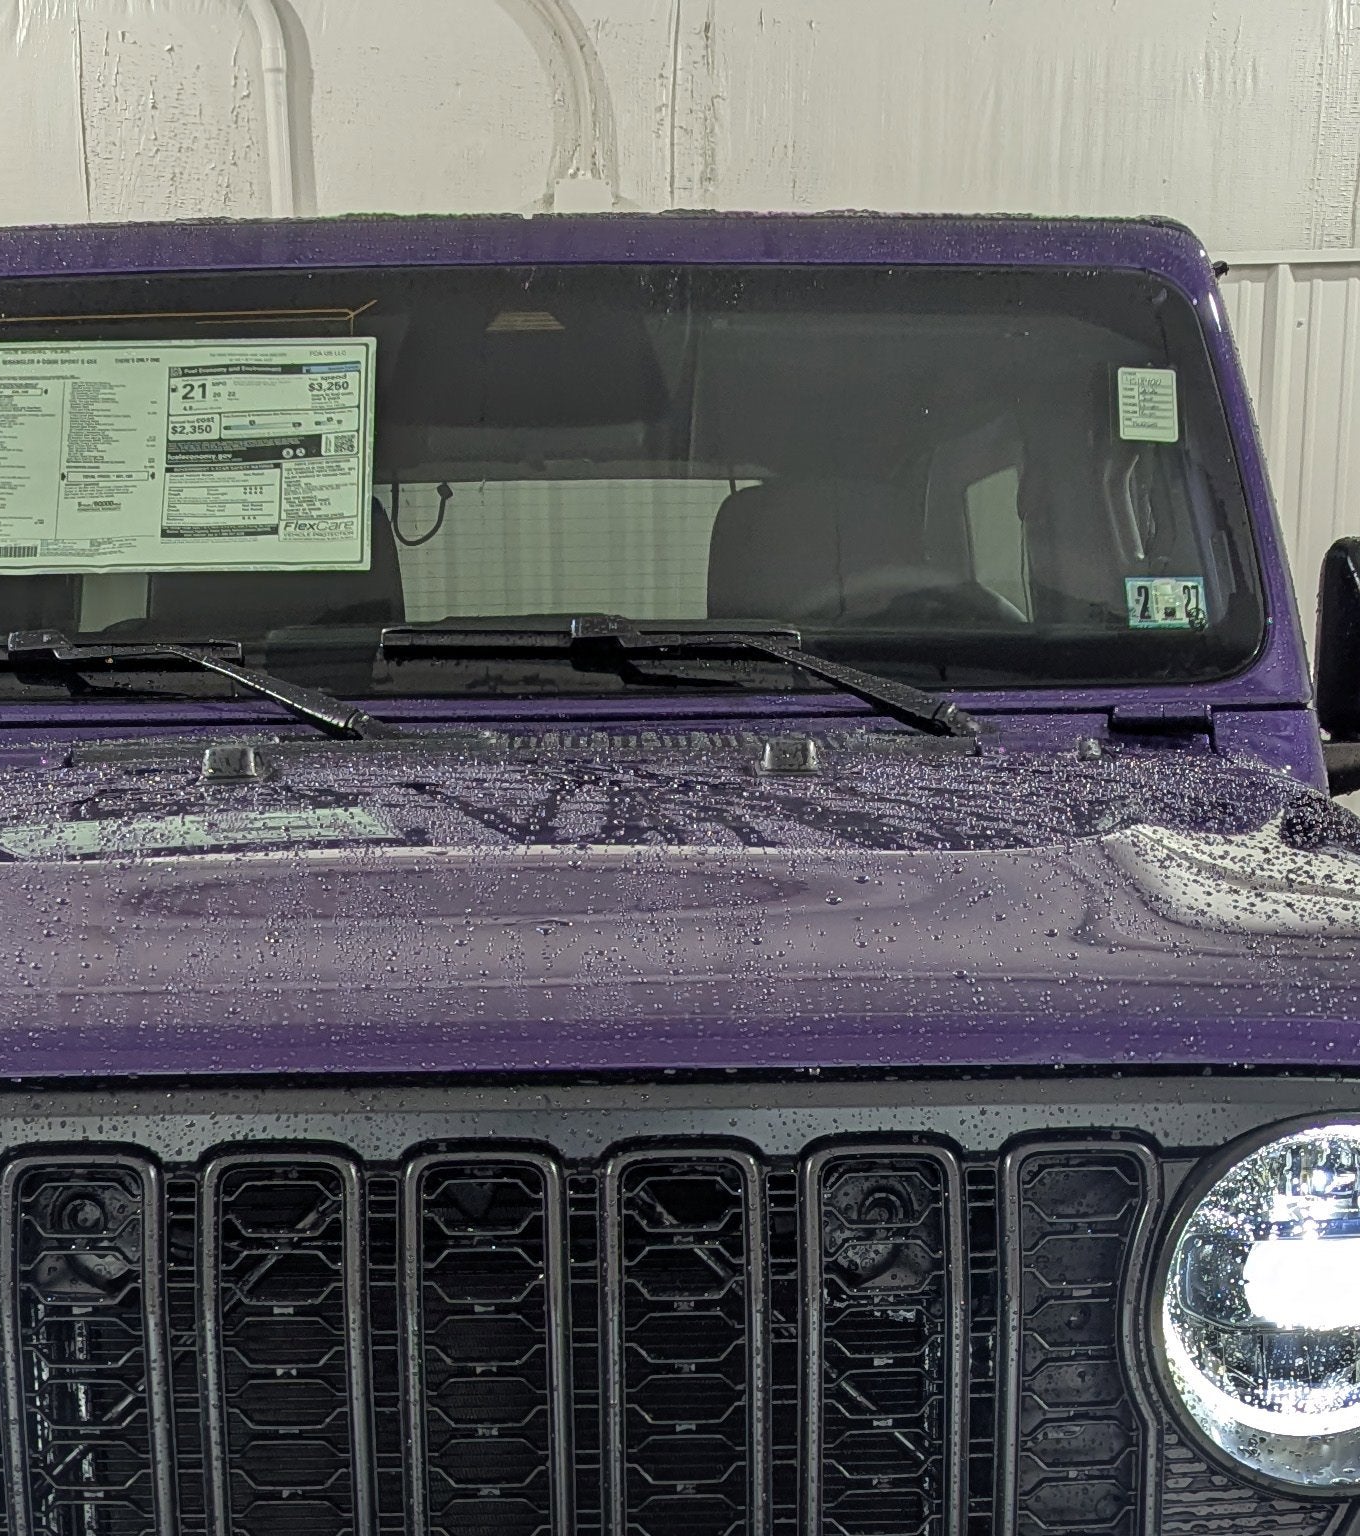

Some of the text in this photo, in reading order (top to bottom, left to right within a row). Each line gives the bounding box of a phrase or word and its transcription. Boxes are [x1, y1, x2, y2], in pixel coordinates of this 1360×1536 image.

[181, 382, 208, 400] 21
[308, 380, 350, 392] $3,250
[170, 424, 213, 436] $2,350
[283, 520, 354, 531] FlexCare
[1136, 585, 1152, 620] 2
[1182, 584, 1200, 620] 27
